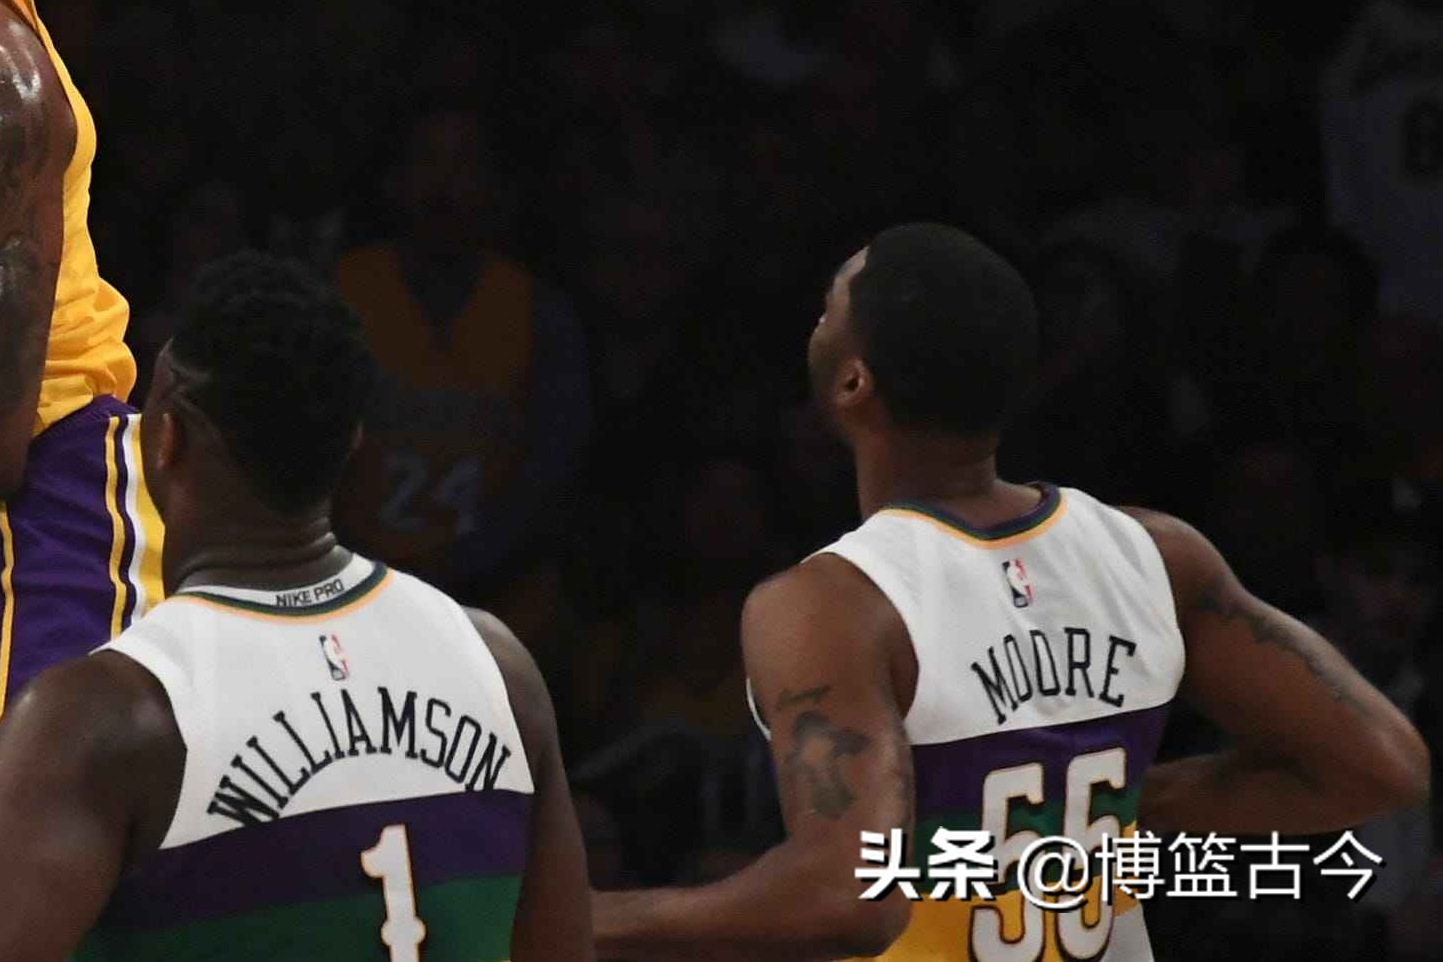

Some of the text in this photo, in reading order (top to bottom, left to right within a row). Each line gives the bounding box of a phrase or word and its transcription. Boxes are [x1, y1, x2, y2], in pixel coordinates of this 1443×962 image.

[275, 578, 345, 606] NIKE PRO
[971, 626, 1137, 726] MOORE
[207, 686, 512, 827] WILLIAMSON
[360, 823, 427, 962] 1
